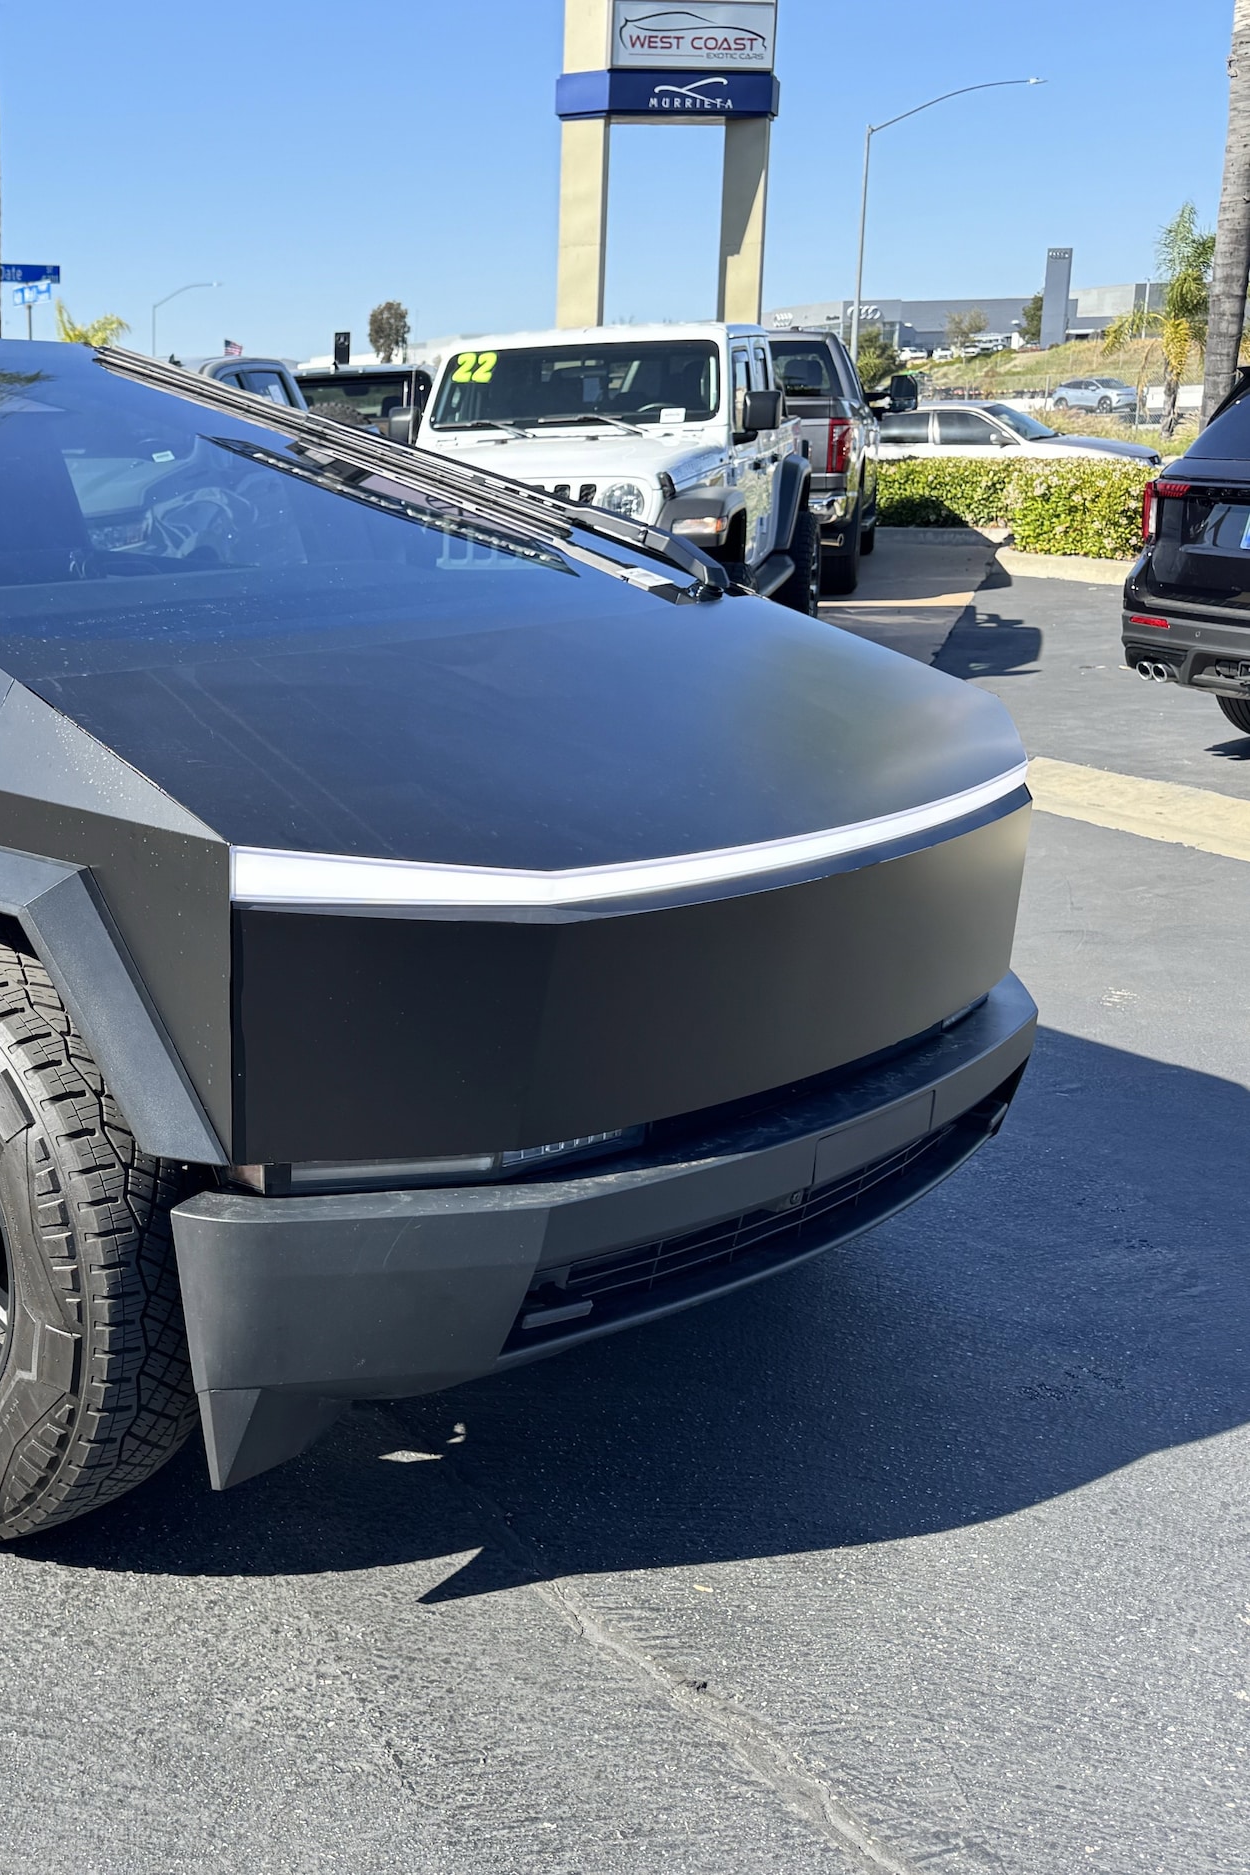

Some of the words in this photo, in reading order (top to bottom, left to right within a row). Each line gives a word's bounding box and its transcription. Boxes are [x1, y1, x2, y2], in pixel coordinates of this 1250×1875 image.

[629, 35, 685, 49] WEST
[691, 36, 758, 51] COAST
[706, 52, 738, 60] EXOTIC
[648, 97, 733, 109] MURRIETA
[451, 351, 498, 384] 22
